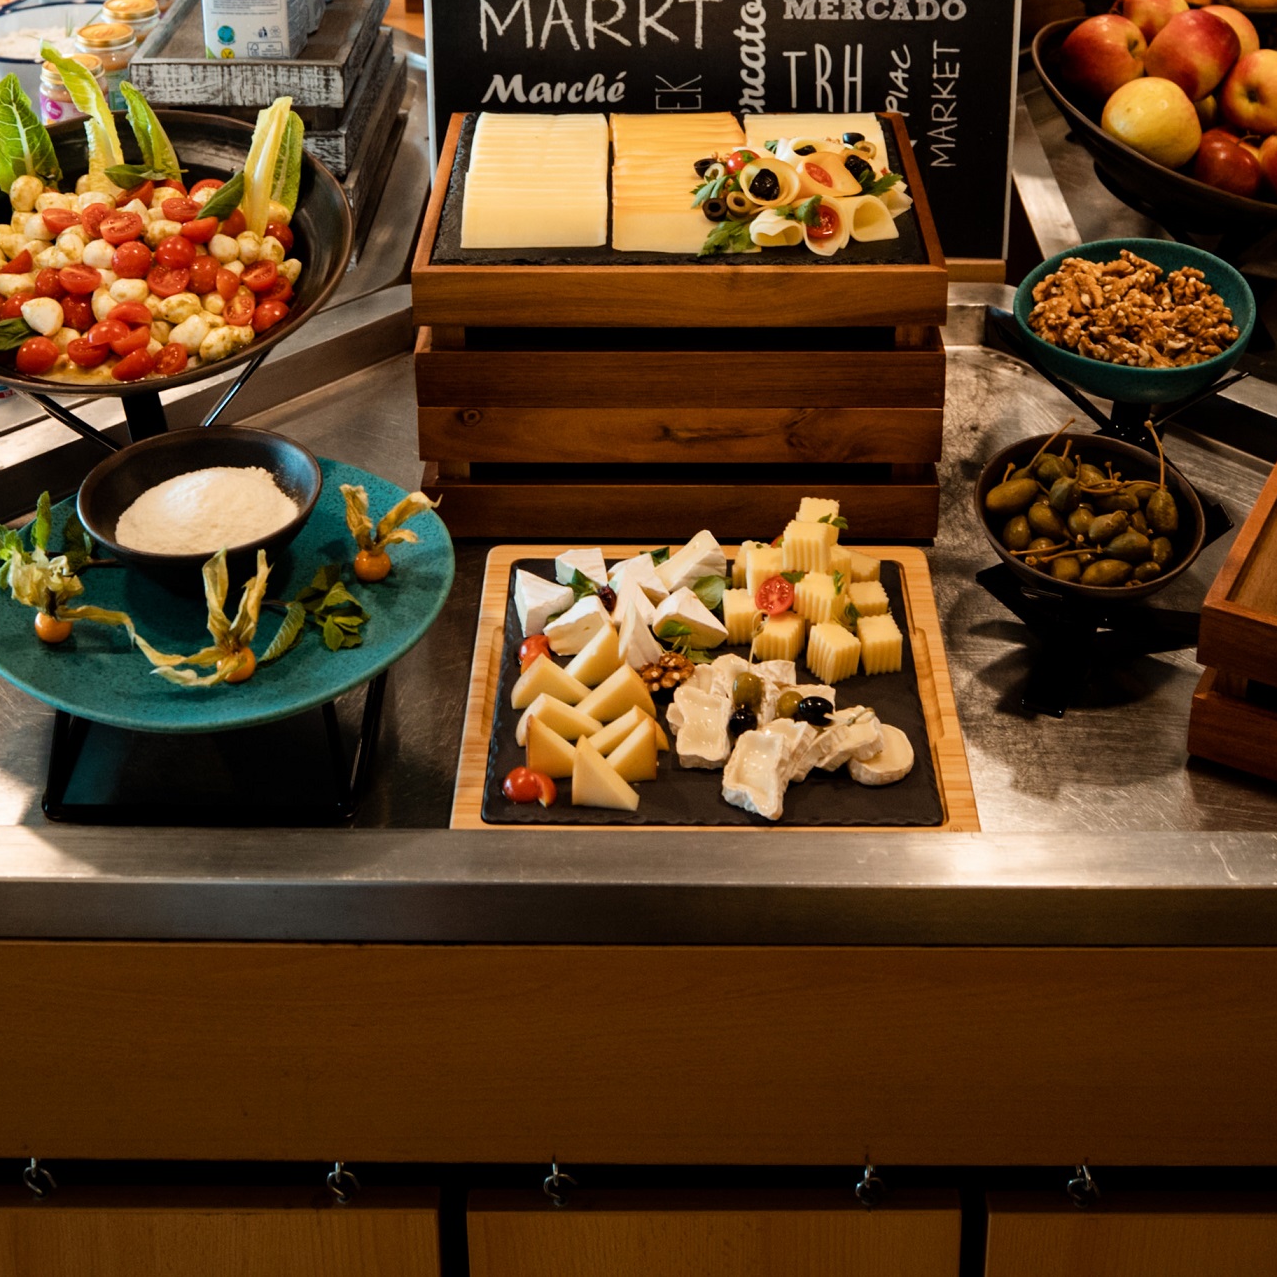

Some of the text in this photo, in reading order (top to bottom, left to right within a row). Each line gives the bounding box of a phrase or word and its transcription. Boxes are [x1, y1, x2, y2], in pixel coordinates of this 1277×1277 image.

[481, 71, 627, 104] Marché
[782, 42, 863, 112] TRH
[885, 44, 911, 117] PIAC
[927, 39, 960, 167] MARKET
